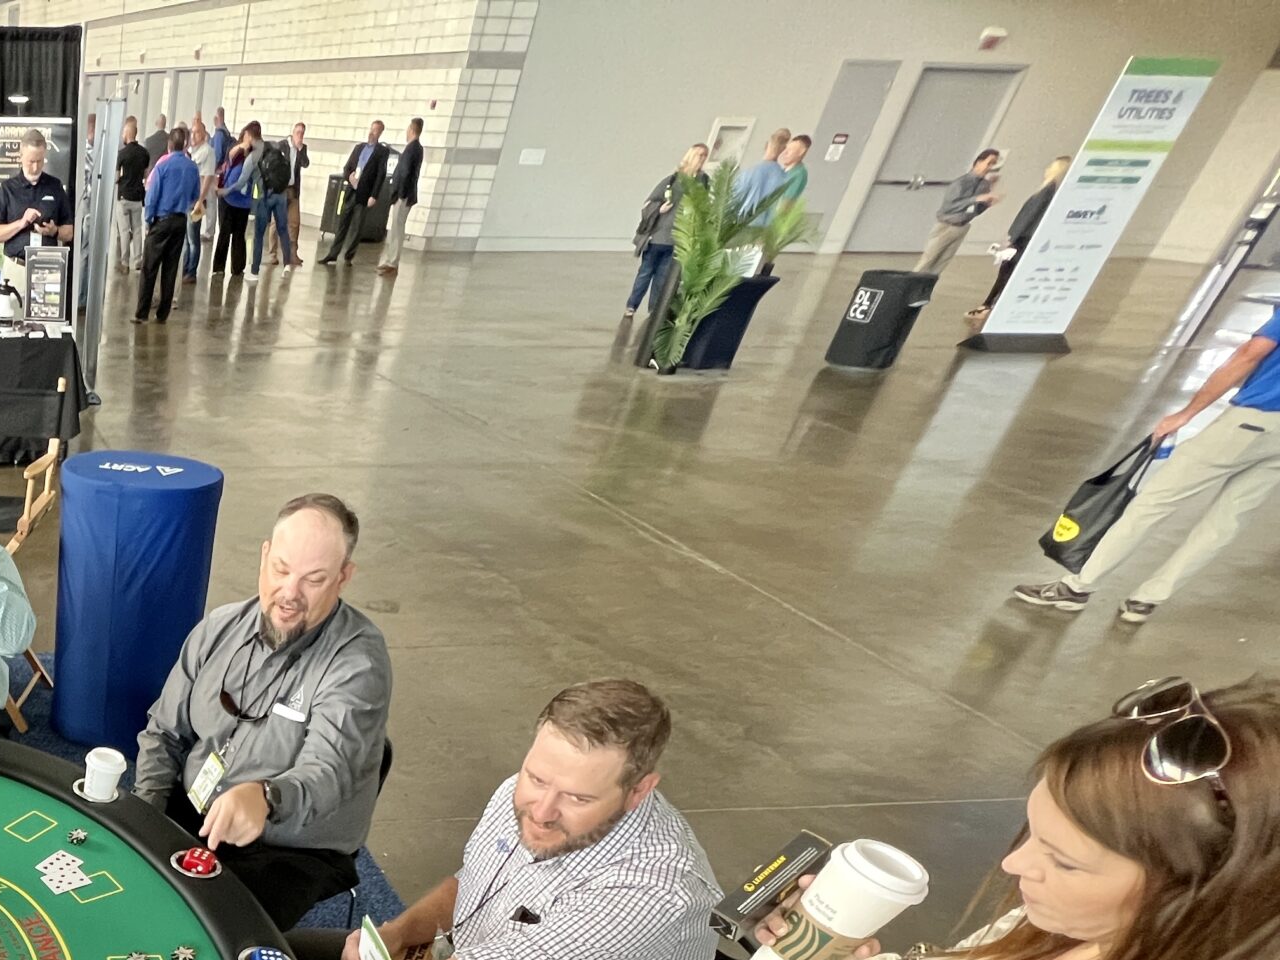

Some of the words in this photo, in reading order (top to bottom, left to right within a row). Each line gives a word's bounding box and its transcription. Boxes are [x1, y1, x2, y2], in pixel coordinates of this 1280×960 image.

[1128, 88, 1173, 104] TREES
[1118, 106, 1176, 120] UTILITIES
[1066, 210, 1096, 219] DAVEY
[854, 290, 871, 305] DL
[849, 304, 868, 319] CC
[99, 462, 152, 473] ACRT
[752, 855, 786, 885] LEATHERMAN
